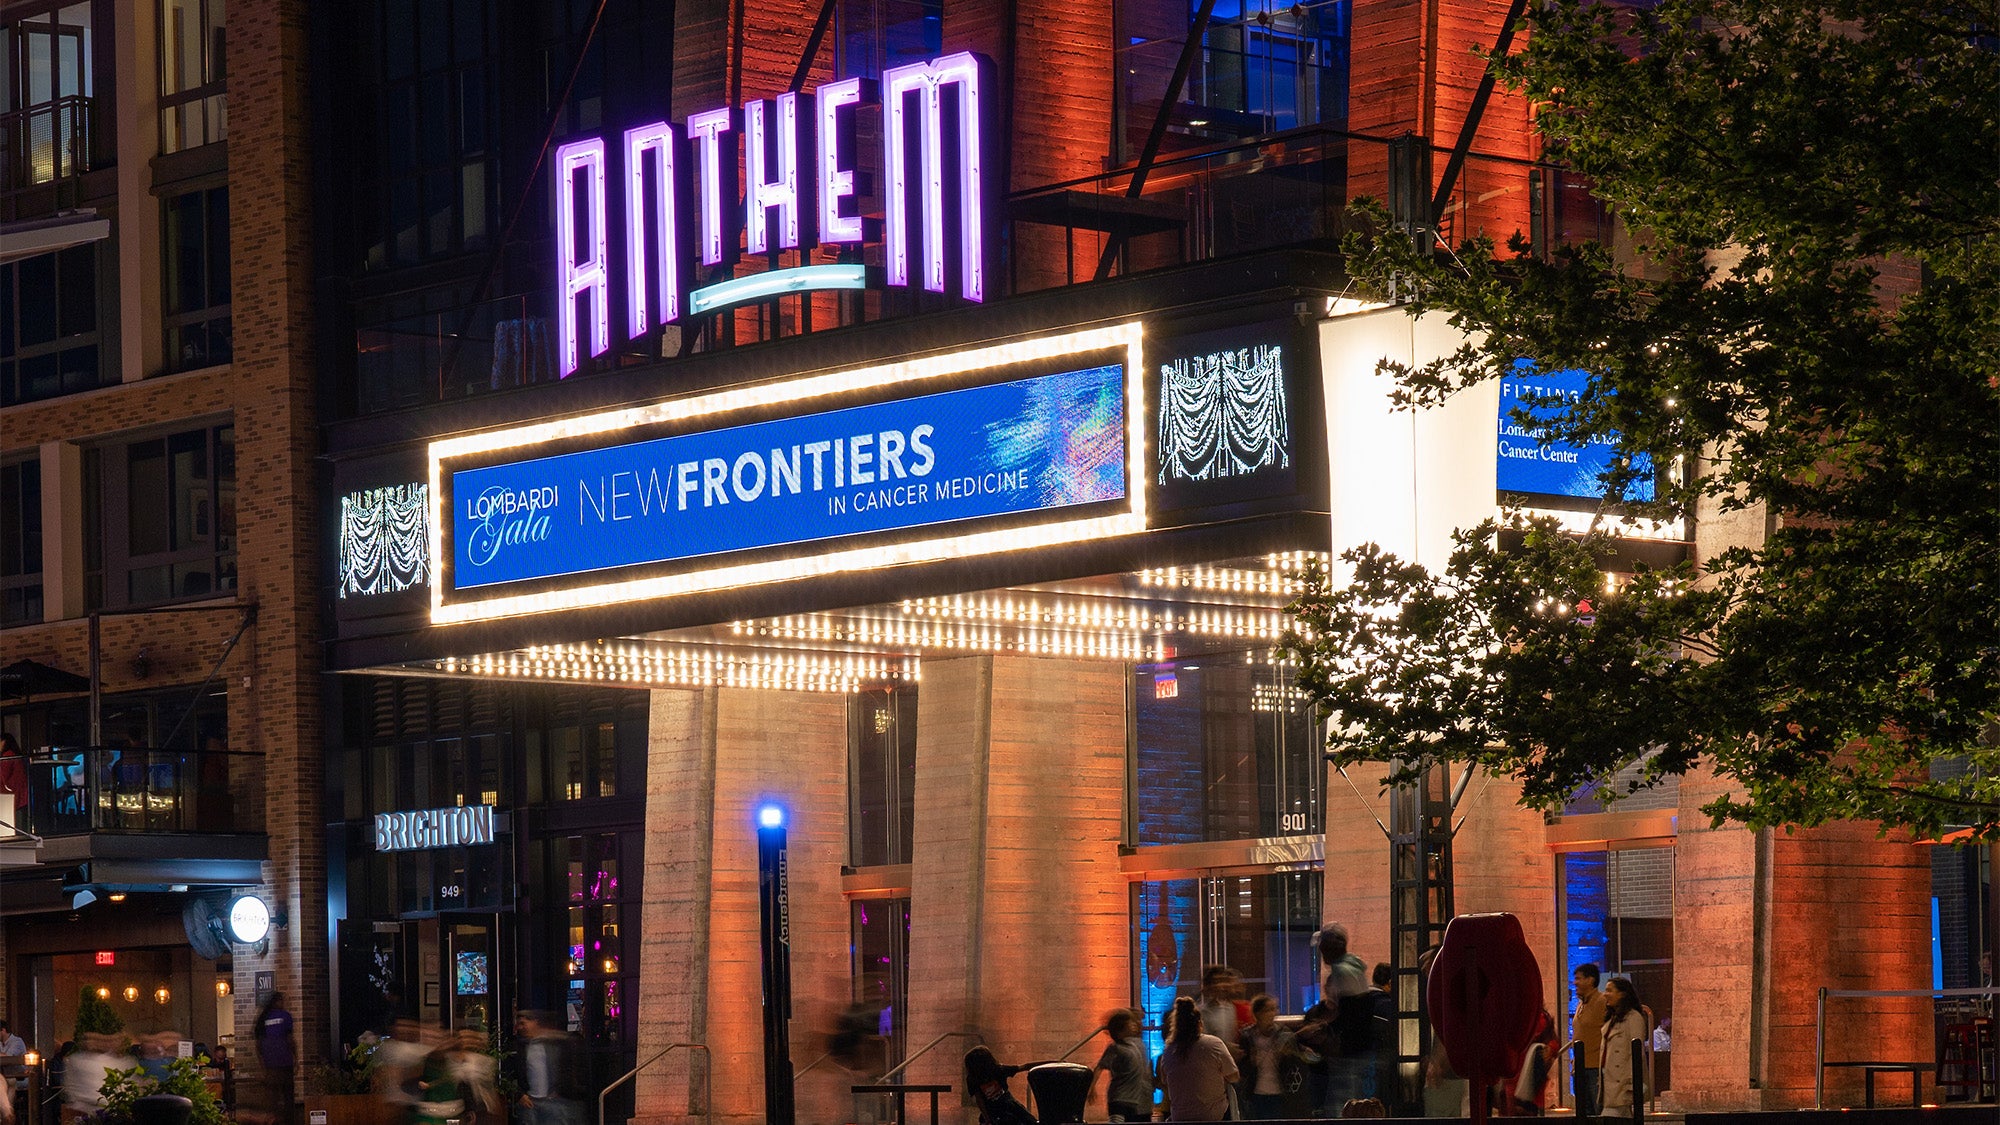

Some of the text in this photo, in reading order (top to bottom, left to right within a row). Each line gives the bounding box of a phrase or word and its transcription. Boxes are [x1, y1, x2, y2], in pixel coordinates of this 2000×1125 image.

[555, 50, 984, 380] ANTHEM
[1503, 383, 1579, 404] FITTING
[1498, 440, 1579, 463] Cancer Center
[467, 485, 558, 520] LOMBARDI
[828, 468, 1029, 516] IN CANCER MEDICINE
[468, 485, 553, 567] Gala
[374, 804, 495, 852] BRIGHTON
[1282, 812, 1306, 831] 901
[441, 885, 460, 898] 949
[777, 849, 790, 946] Emergency
